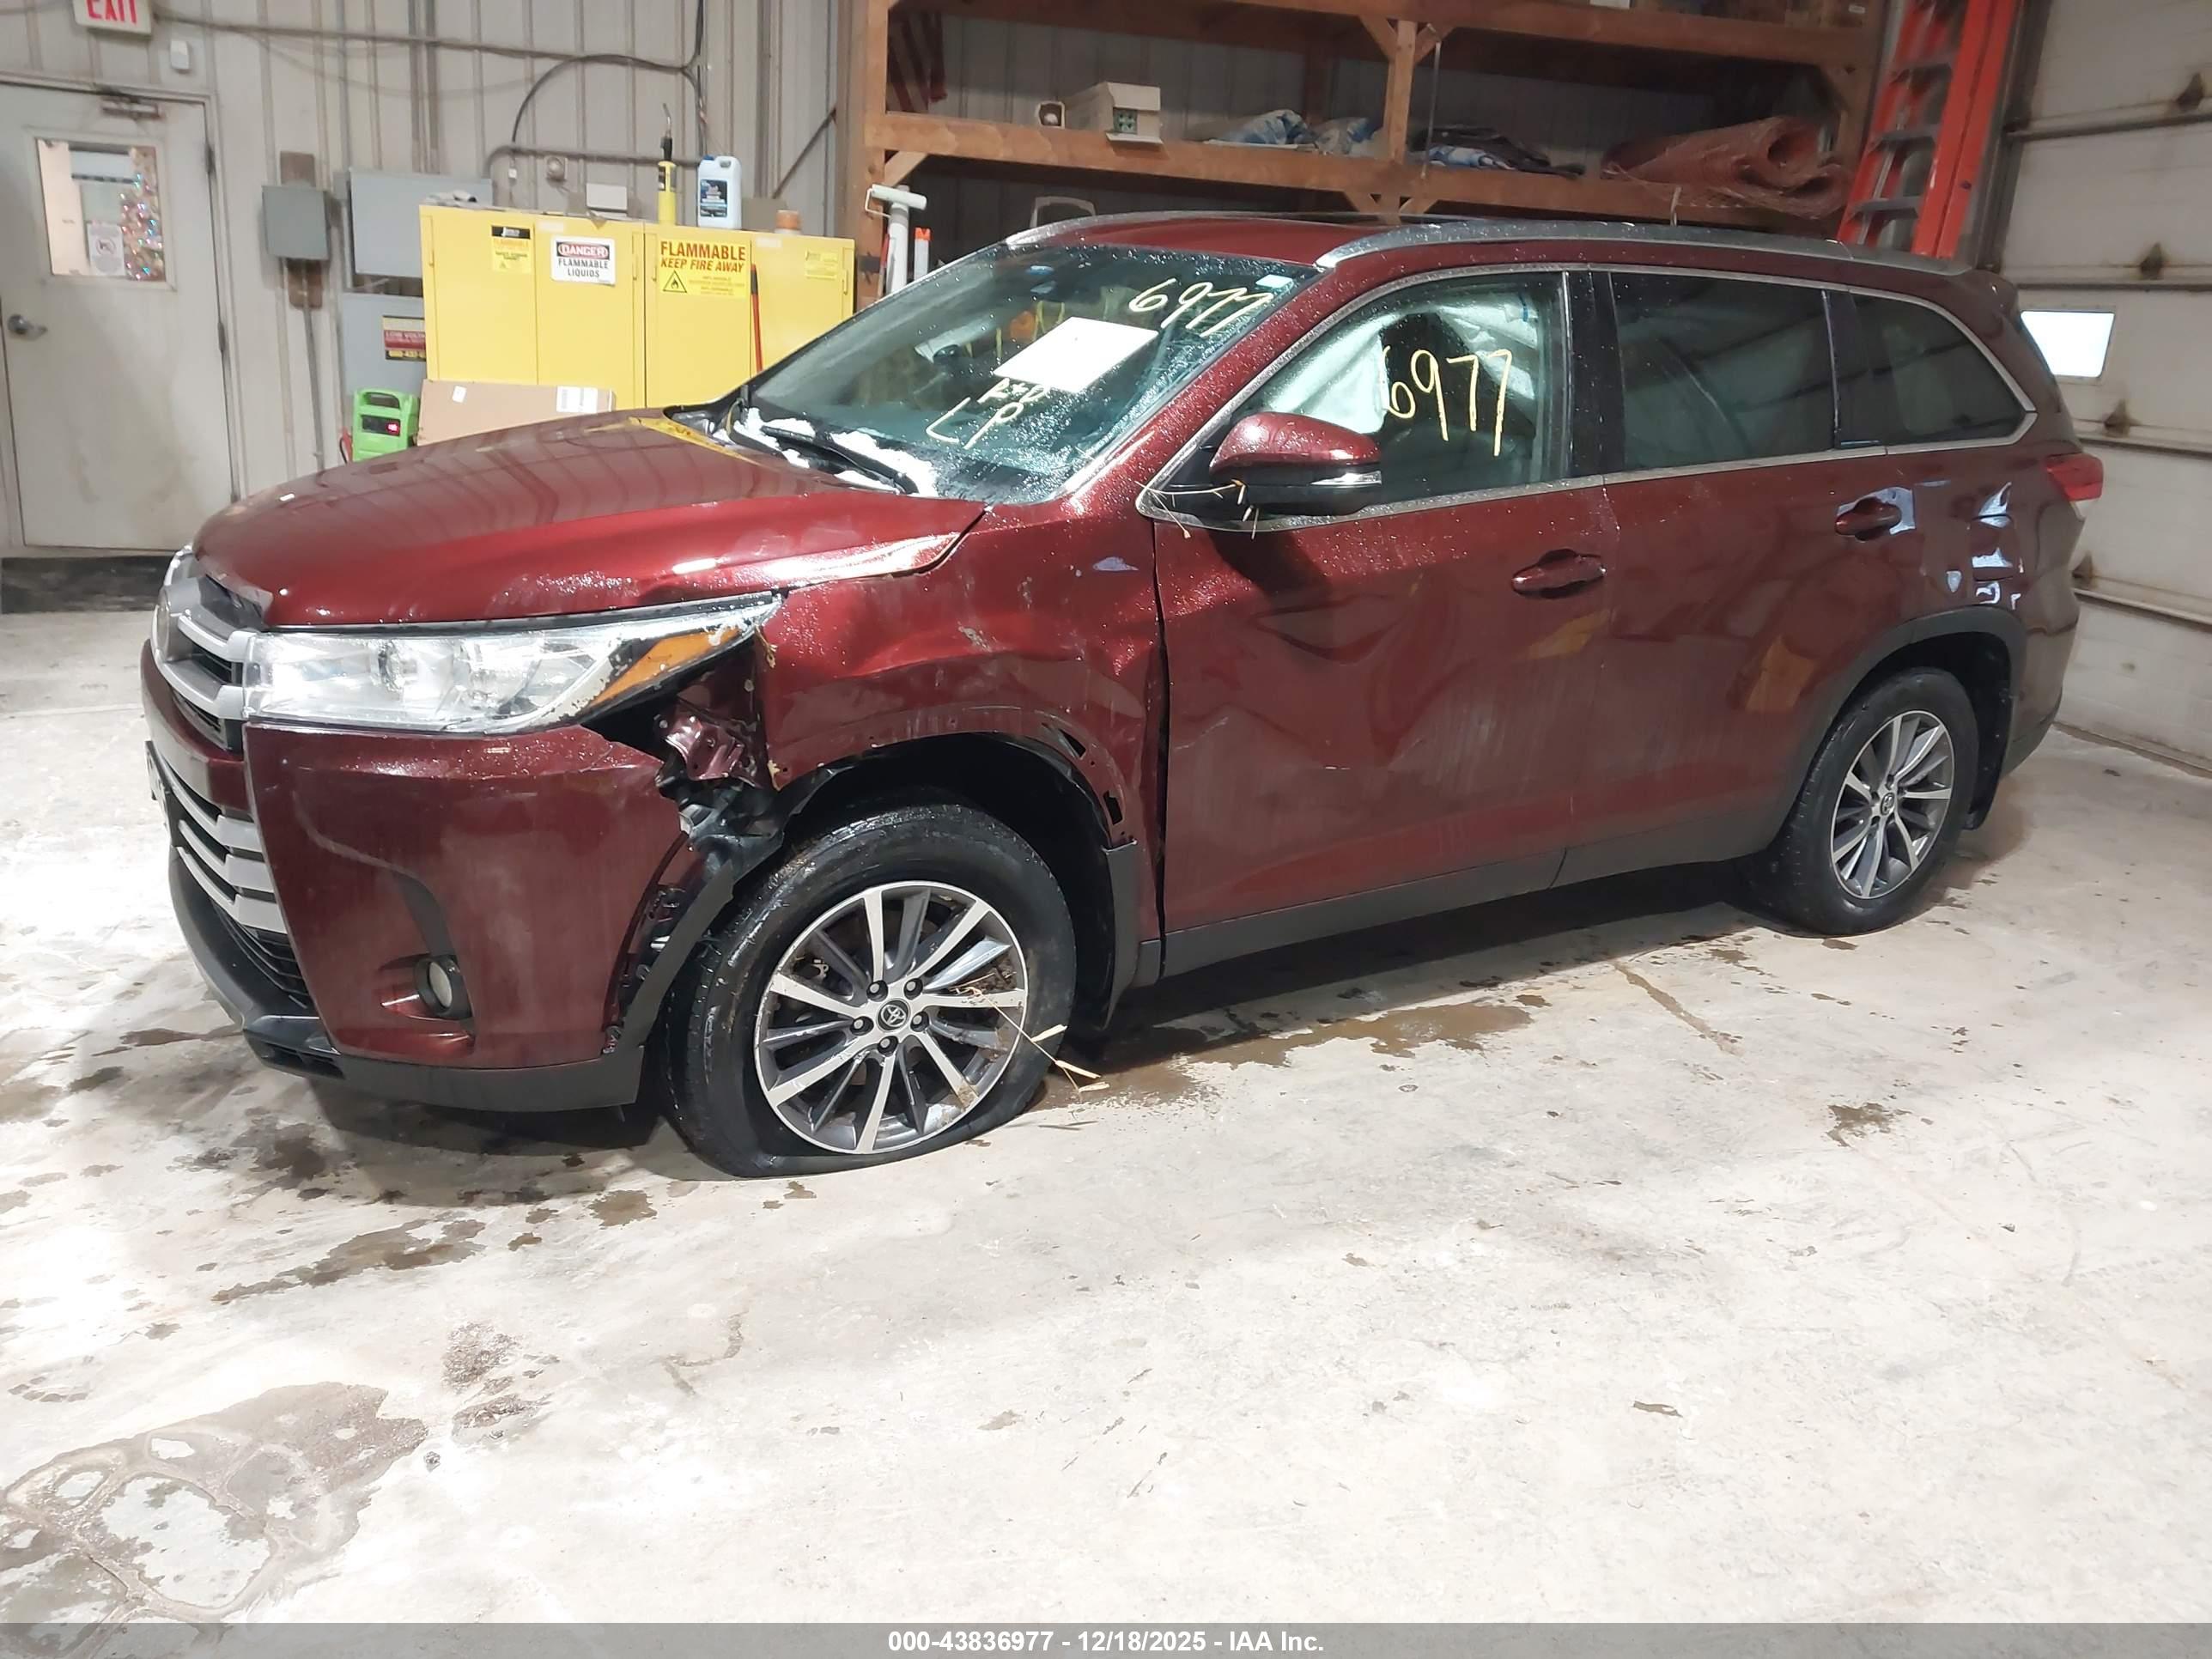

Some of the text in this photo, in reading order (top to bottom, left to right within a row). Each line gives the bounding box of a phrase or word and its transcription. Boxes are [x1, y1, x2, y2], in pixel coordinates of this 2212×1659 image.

[86, 0, 137, 24] EXIT
[561, 244, 606, 257] DANGER
[660, 241, 745, 261] FLAMMABLE
[558, 258, 609, 269] FLAMMABLE
[660, 258, 744, 273] KEEP FIRE AWAY
[1128, 277, 1274, 337] 6977
[1381, 345, 1513, 457] 6977
